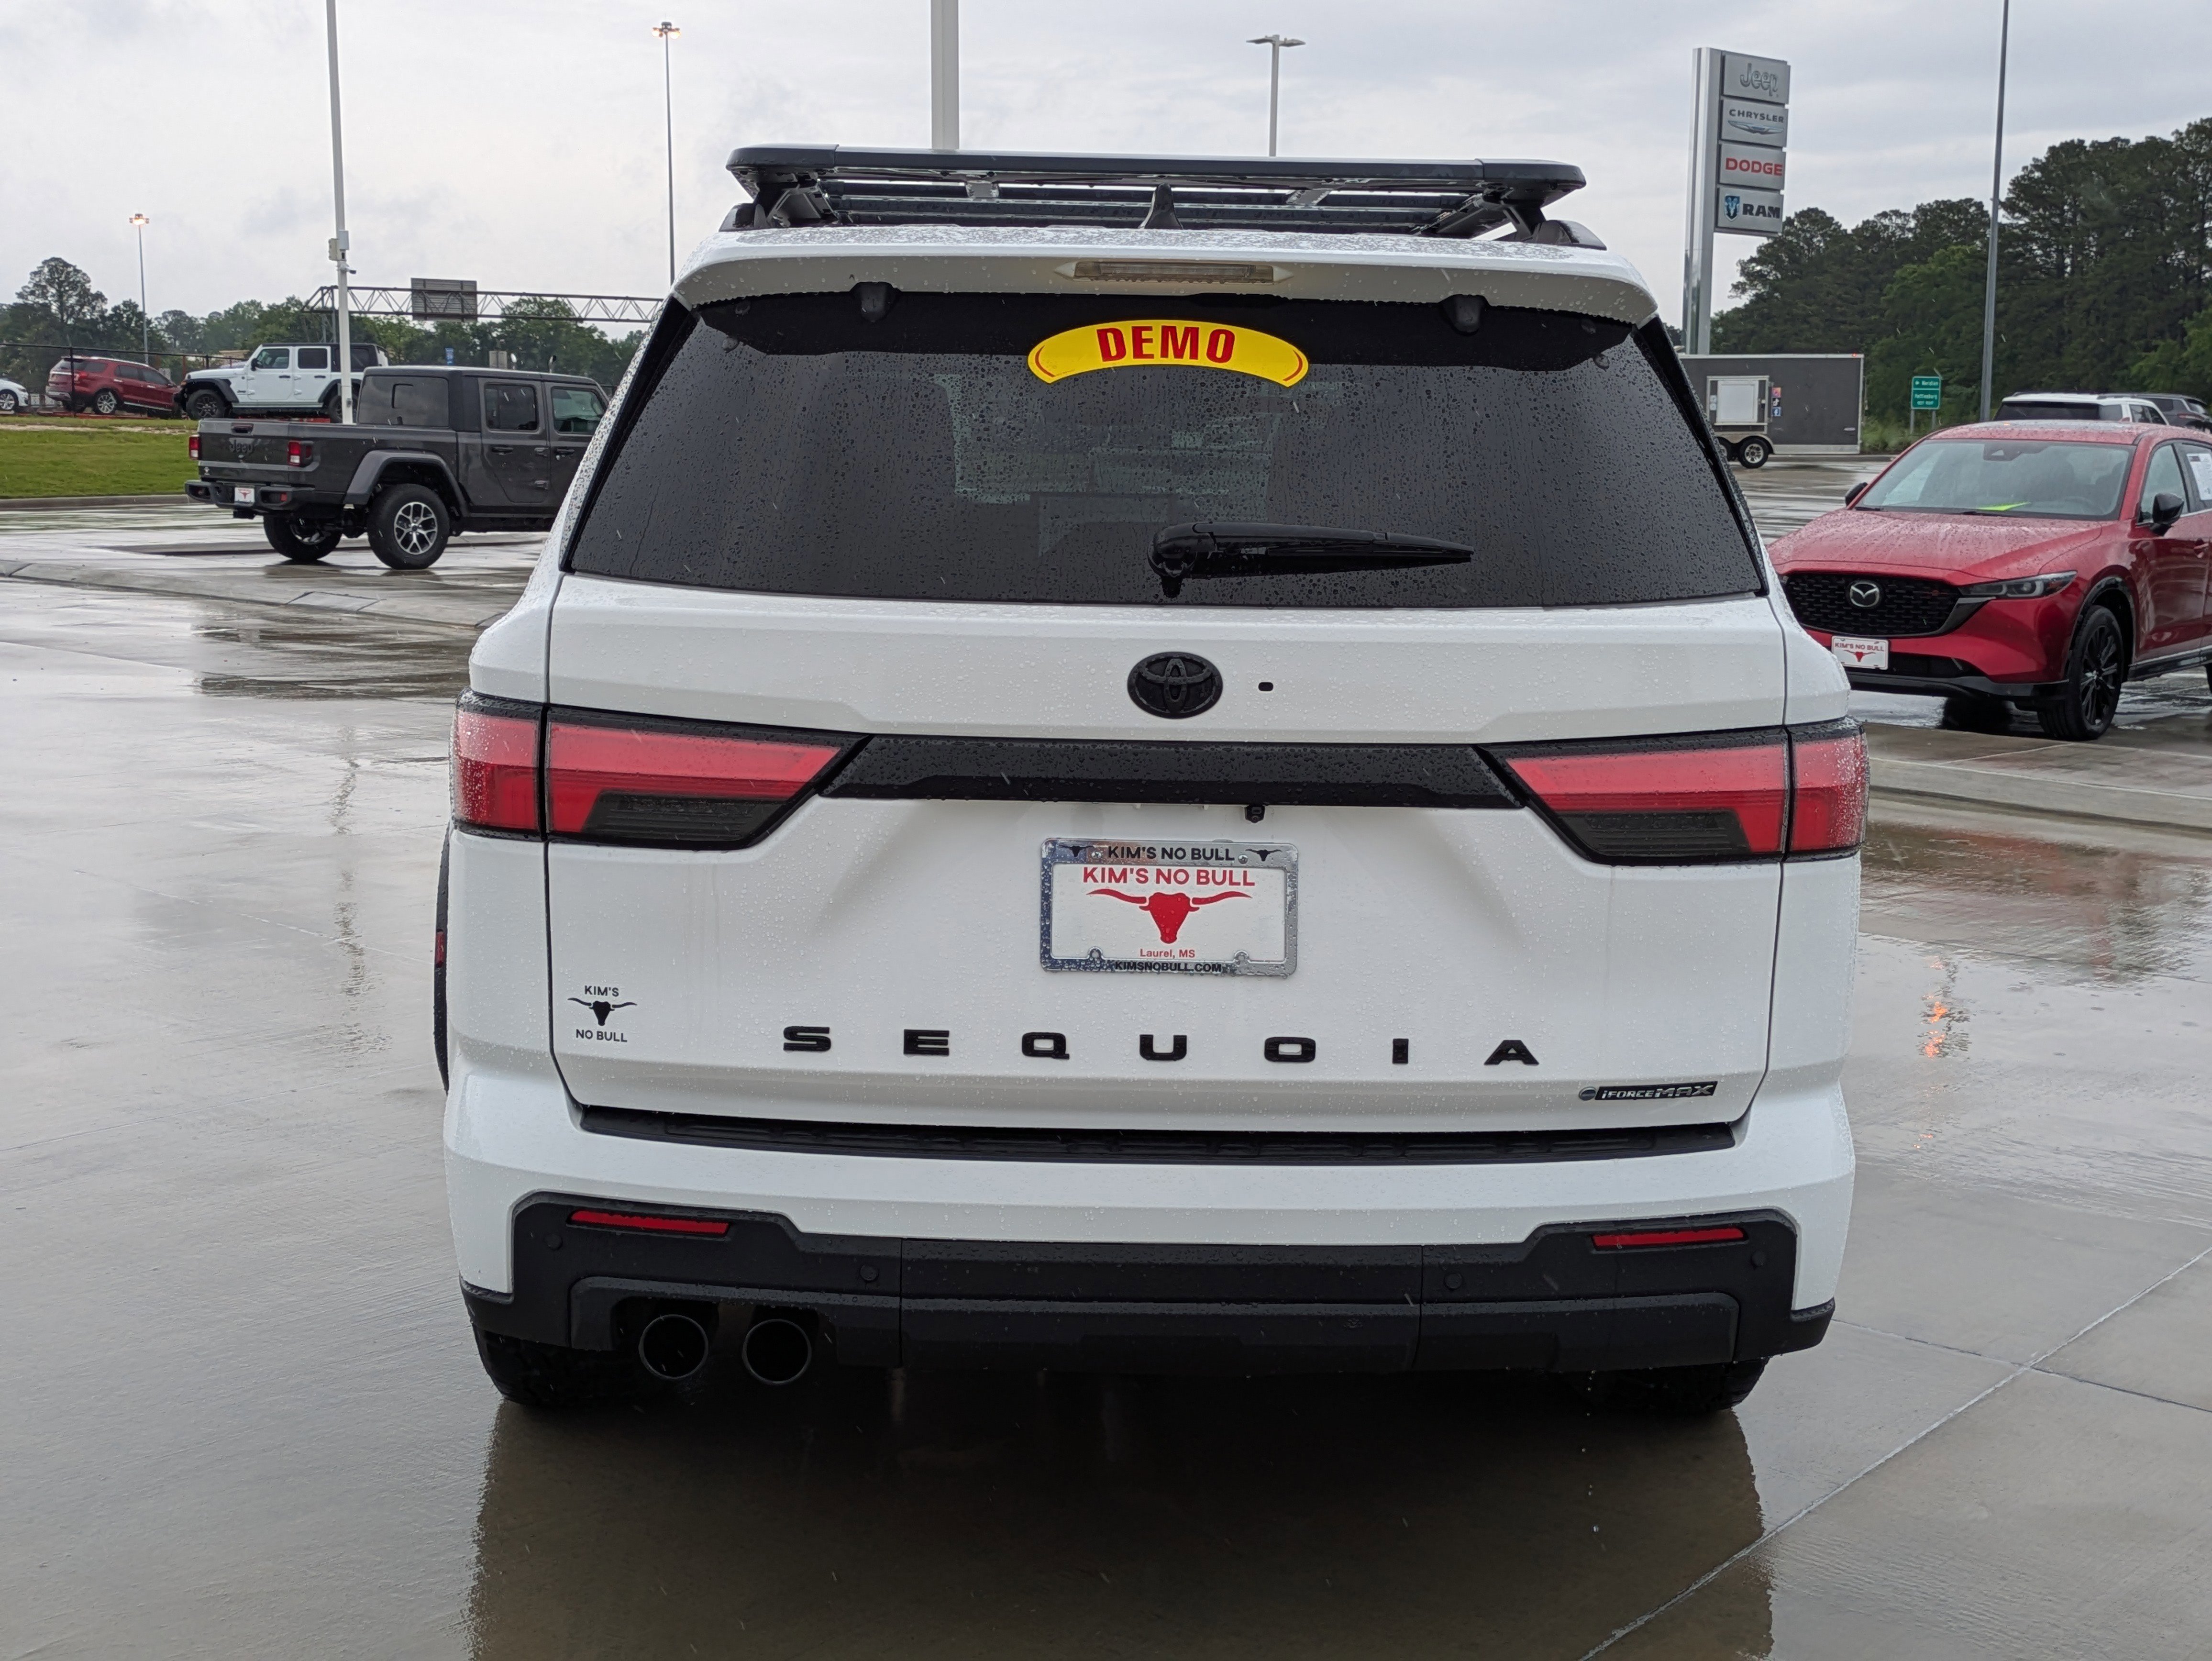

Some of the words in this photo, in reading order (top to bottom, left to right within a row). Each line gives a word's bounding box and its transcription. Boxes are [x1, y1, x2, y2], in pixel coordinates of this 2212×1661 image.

[1740, 63, 1779, 97] Jeep
[1729, 109, 1784, 123] CHRYSLER
[1725, 158, 1783, 177] DODGE
[1742, 203, 1780, 219] RAM
[1096, 325, 1235, 363] DEMO
[1108, 846, 1156, 859] KIM'S
[1161, 847, 1186, 861] NO
[1191, 848, 1235, 862] BULL
[1084, 867, 1149, 884] KIM'S
[1156, 869, 1189, 885] NO
[1196, 870, 1255, 886] BULL
[1140, 949, 1175, 959] Laurel,
[1179, 950, 1195, 958] MS
[1115, 961, 1222, 973] KIMSNOBULL.COM
[585, 986, 619, 997] KIM'S
[576, 1029, 593, 1040] NO
[597, 1031, 628, 1042] BULL
[783, 1025, 1539, 1065] SEQUOIA
